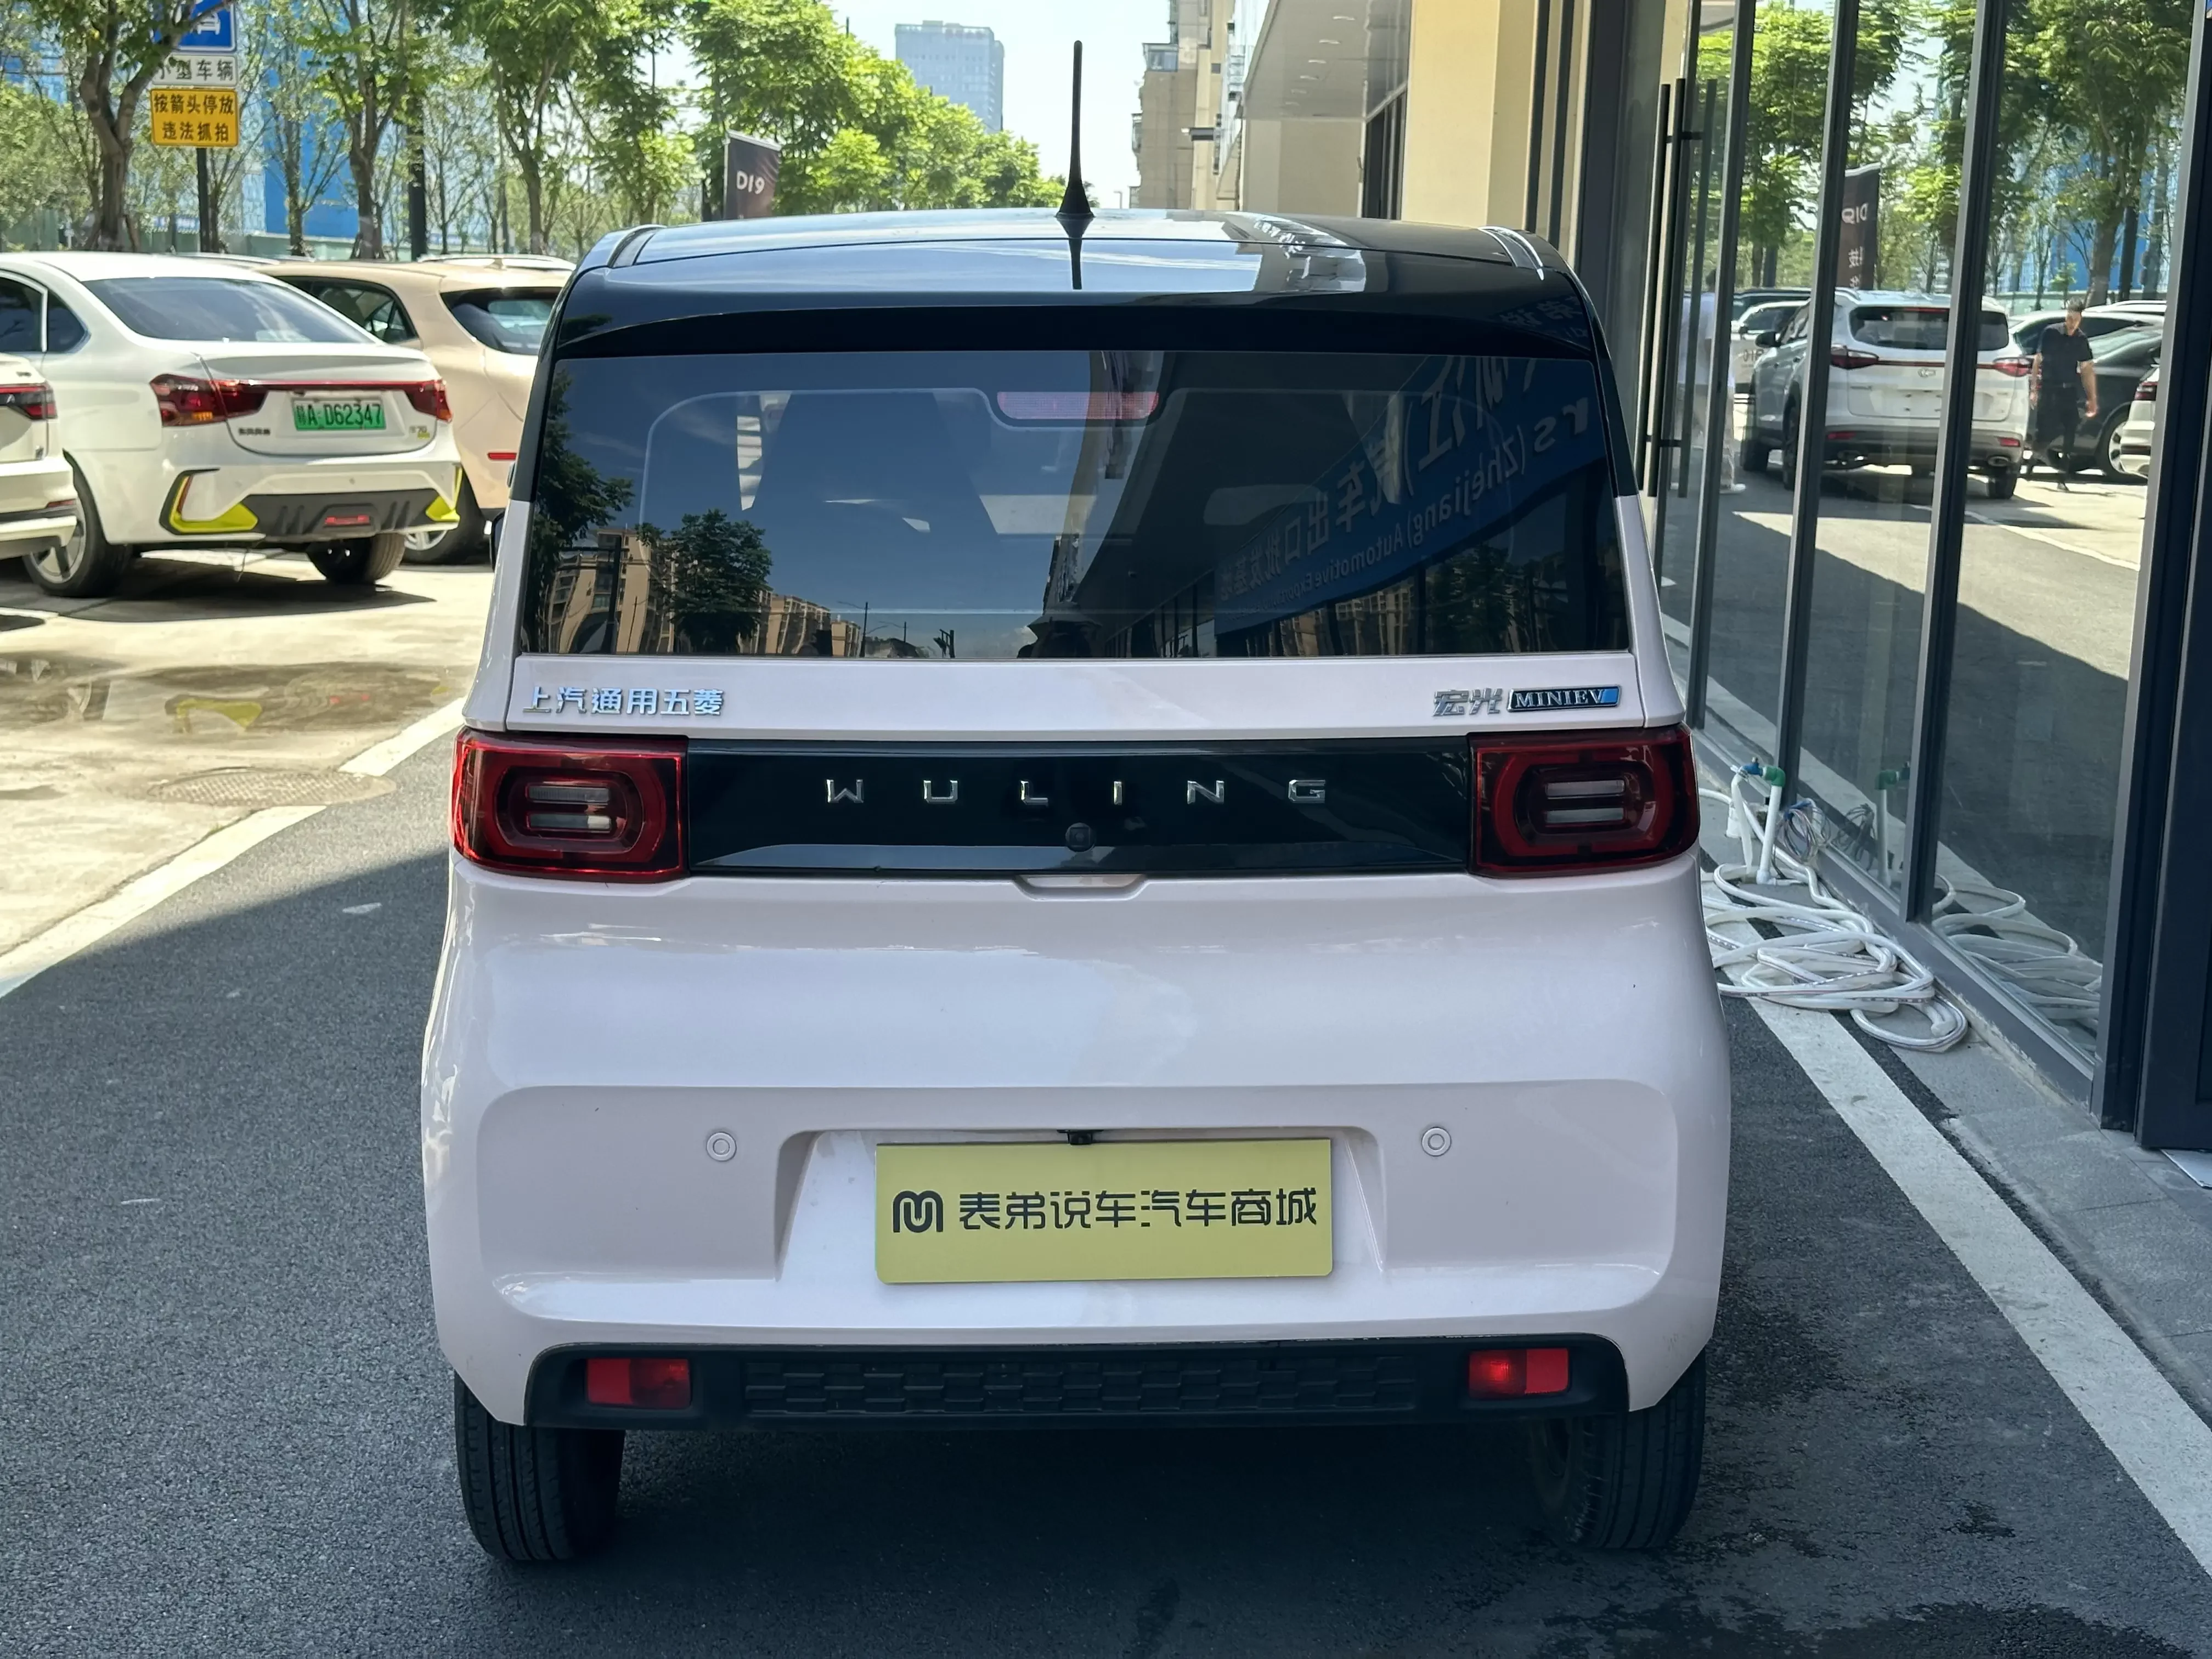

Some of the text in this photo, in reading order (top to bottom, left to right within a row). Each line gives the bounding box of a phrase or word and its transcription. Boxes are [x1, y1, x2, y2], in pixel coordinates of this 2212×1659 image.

[153, 93, 234, 115] 按箭头停放
[162, 121, 229, 143] 违法抓拍
[522, 686, 725, 716] 上汽通用五菱
[1432, 687, 1503, 717] 宏光
[827, 778, 1325, 806] WULING
[959, 1187, 1317, 1230] 表弟说车汽车商城
